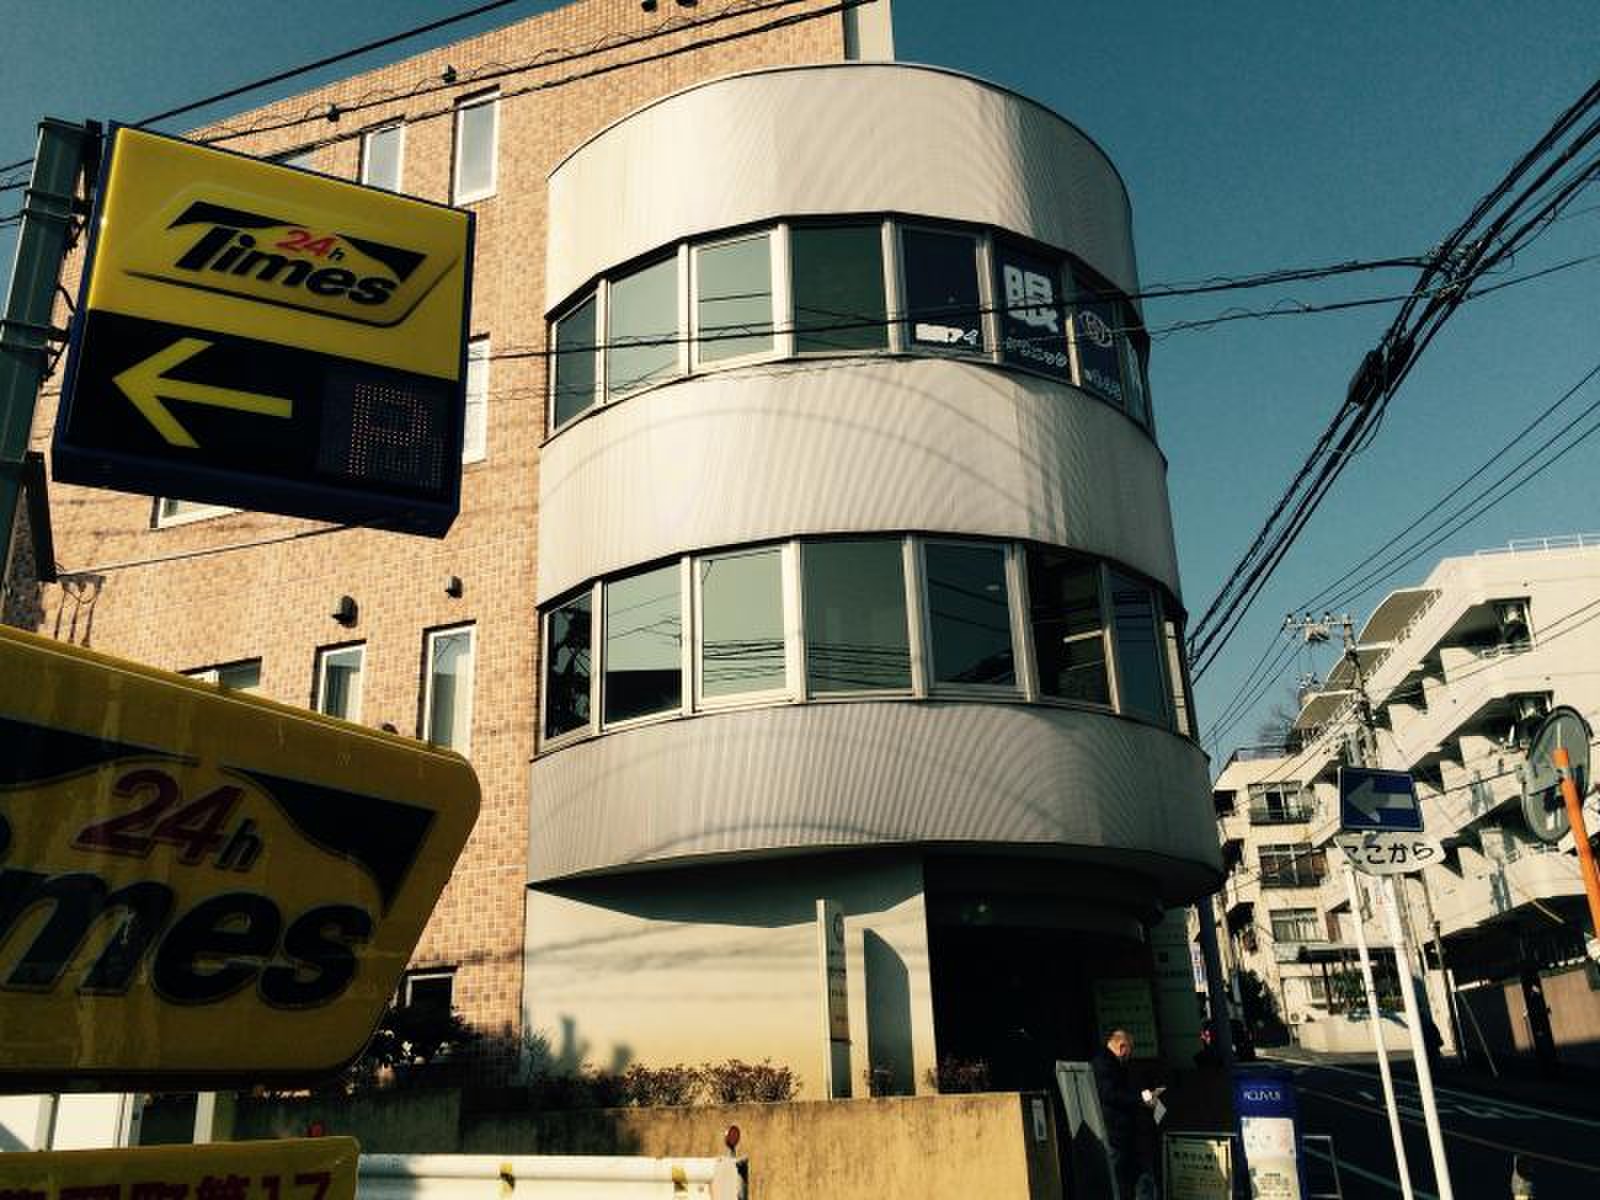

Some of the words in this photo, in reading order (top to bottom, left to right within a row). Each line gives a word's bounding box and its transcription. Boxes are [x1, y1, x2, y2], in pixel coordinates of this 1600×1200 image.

[172, 225, 398, 305] Times
[275, 230, 346, 261] 24h
[348, 382, 432, 481] P
[70, 769, 265, 873] 24h
[1343, 841, 1435, 864] ここから
[0, 814, 374, 1010] mes
